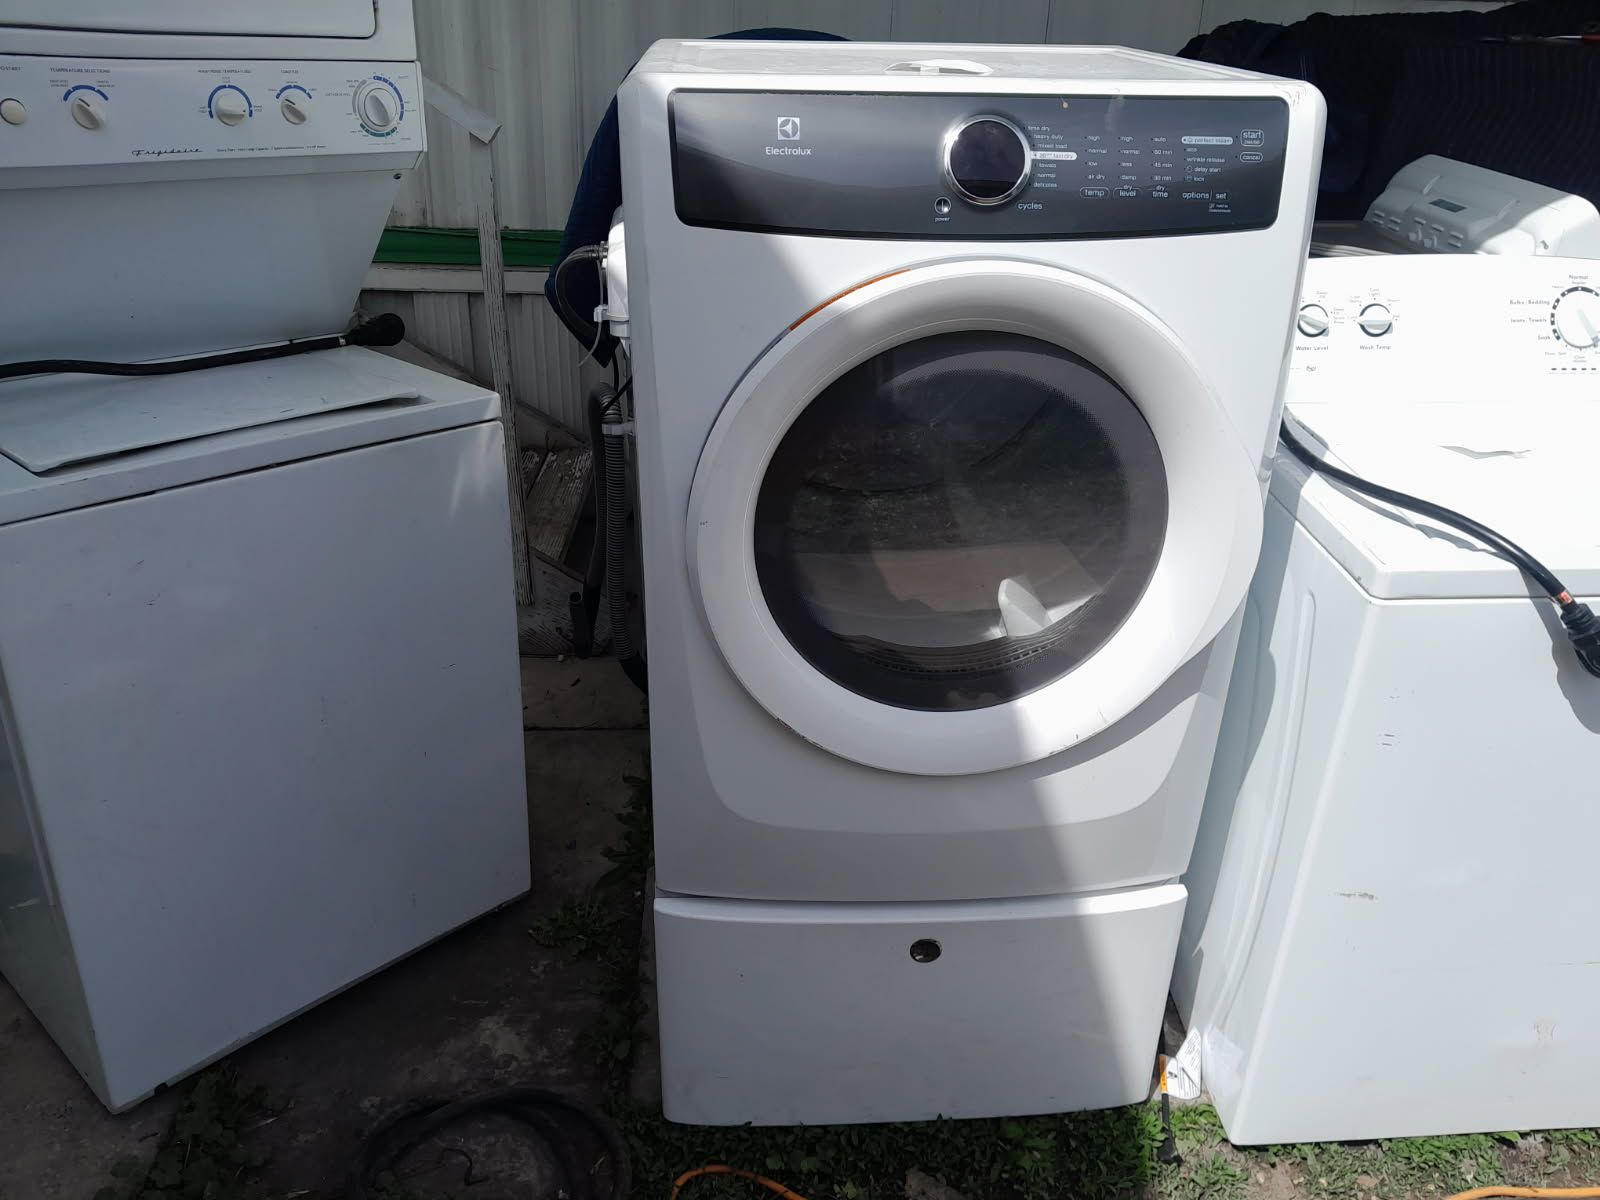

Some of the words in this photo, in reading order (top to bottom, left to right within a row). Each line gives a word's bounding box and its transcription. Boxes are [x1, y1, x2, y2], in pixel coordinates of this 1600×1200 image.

[1242, 130, 1262, 139] start
[765, 146, 812, 156] Electrolux
[1194, 166, 1208, 174] delay
[1084, 189, 1105, 197] temp
[1119, 189, 1137, 197] level
[1152, 190, 1169, 198] time
[1182, 191, 1210, 200] options
[1215, 192, 1227, 200] set
[1017, 201, 1043, 210] cycles
[1376, 343, 1392, 351] Temp
